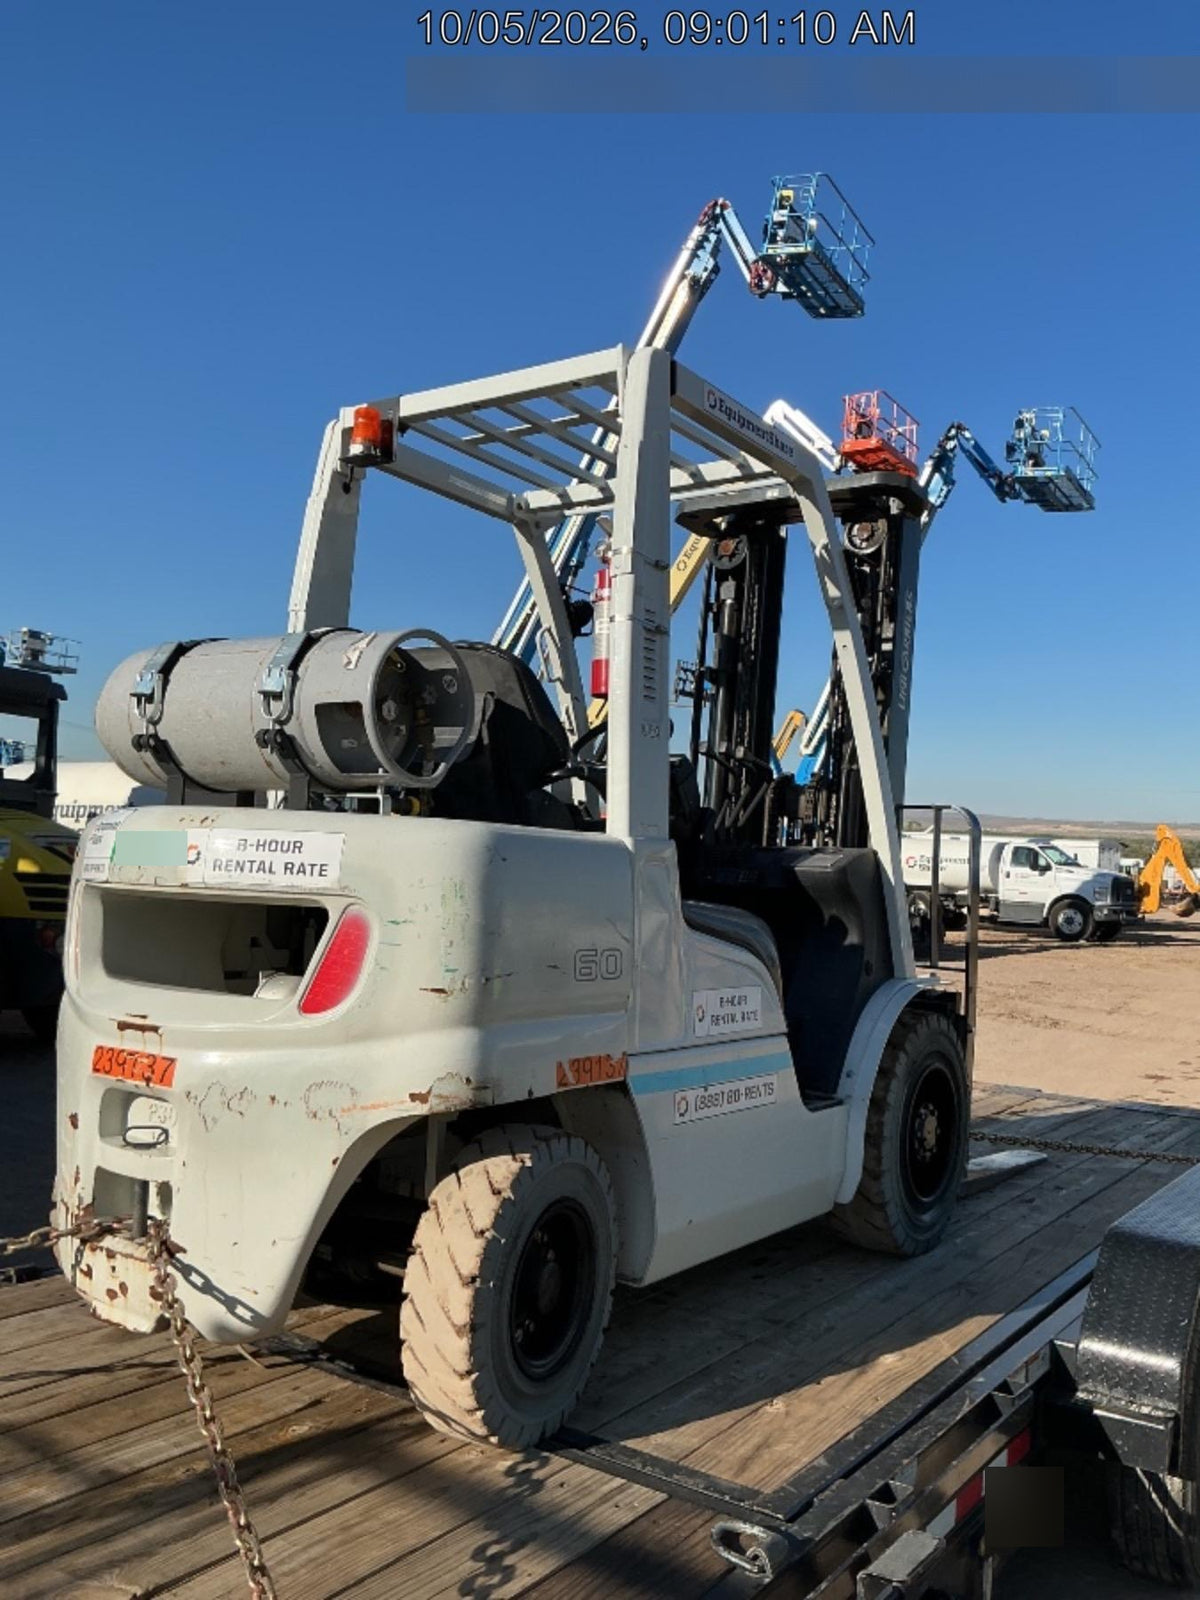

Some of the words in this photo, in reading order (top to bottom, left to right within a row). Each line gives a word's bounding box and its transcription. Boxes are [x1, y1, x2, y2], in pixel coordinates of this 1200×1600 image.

[212, 858, 276, 875] RENTAL
[283, 861, 329, 877] RATE
[574, 948, 623, 982] 60
